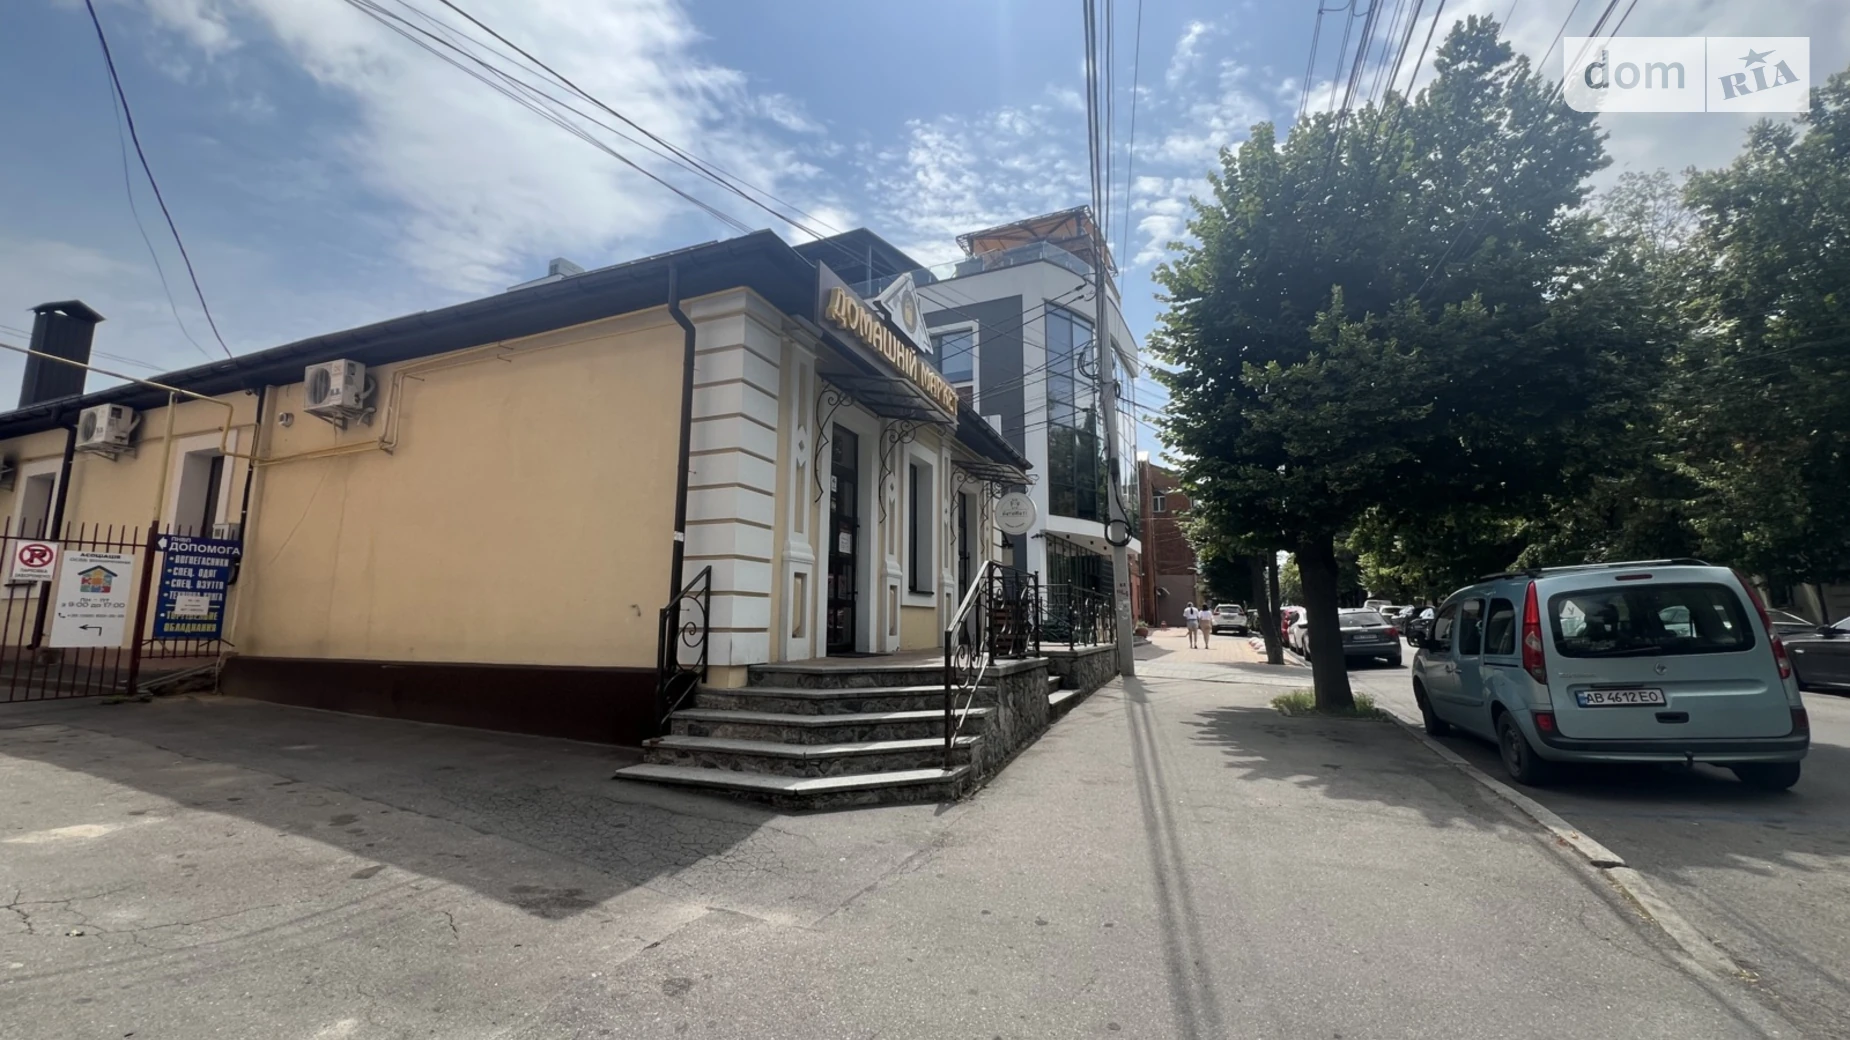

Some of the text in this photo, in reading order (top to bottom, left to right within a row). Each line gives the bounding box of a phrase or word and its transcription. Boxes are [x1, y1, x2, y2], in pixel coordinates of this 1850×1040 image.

[825, 286, 959, 416] ДОМАШНІЙ МАРКЕТ
[168, 542, 240, 555] ДОПОМОГА
[174, 555, 229, 567] ВОГНЕГАСНИКИ
[173, 567, 218, 579] СПЕЦ. ОДЯГ
[171, 578, 224, 590] СПЕЦ. ВЗУТТЯ
[164, 623, 217, 633] ОБЛАДНАННЯ
[1586, 691, 1658, 703] AB 4612 EO
